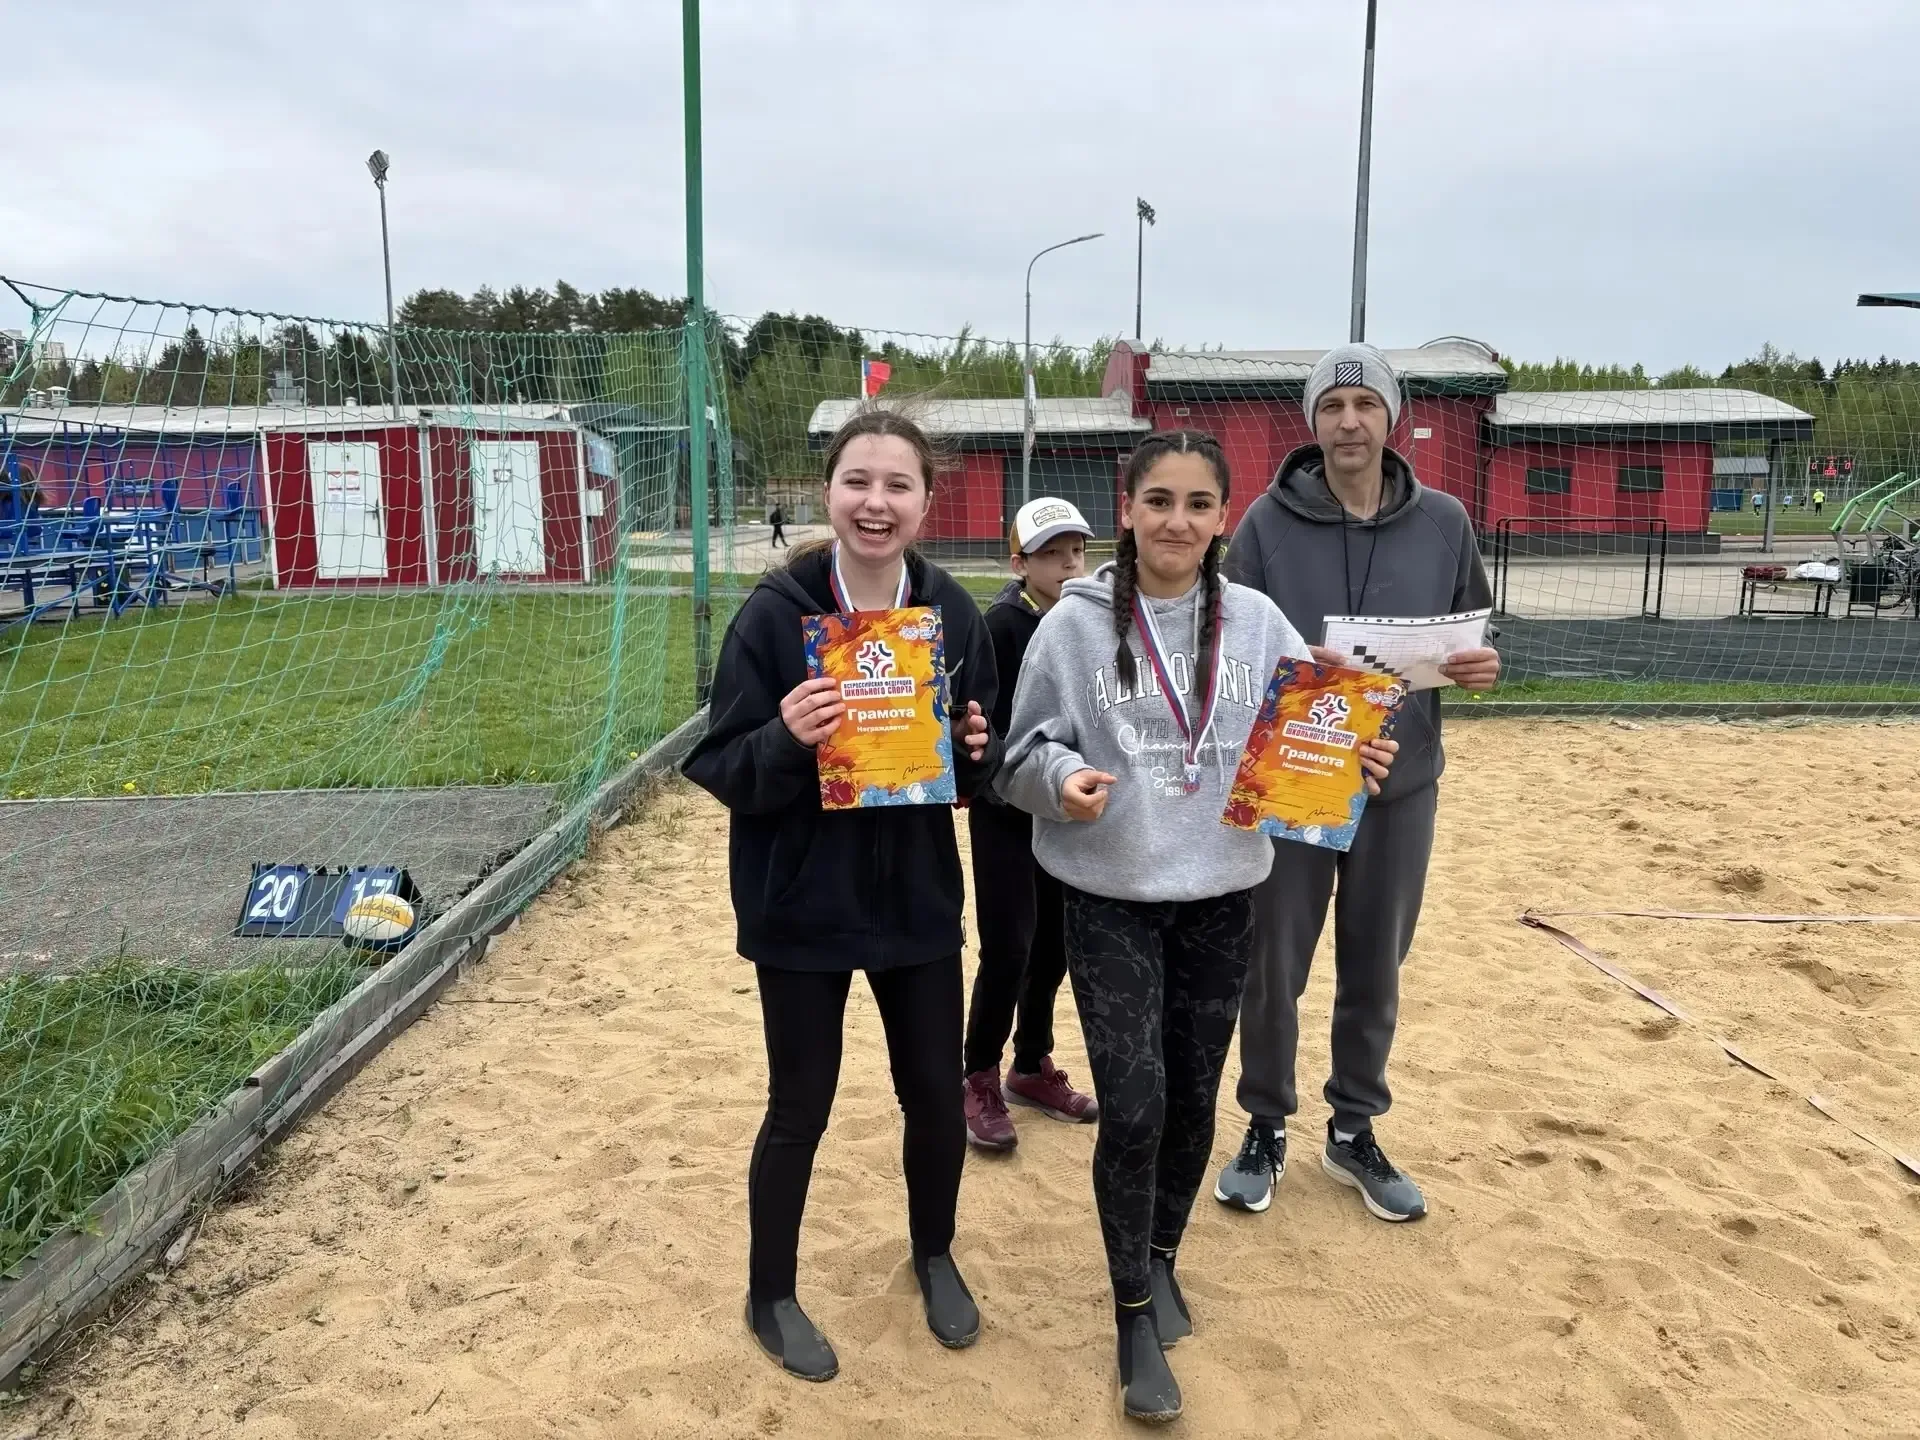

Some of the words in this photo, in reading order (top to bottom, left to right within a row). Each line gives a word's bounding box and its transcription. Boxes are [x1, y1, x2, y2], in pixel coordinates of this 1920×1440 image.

[844, 681, 883, 689] ВСЕРОССИЙСКАЯ
[884, 679, 912, 687] ФЕДЕРАЦИЯ
[844, 687, 886, 697] ШКОЛЬНОГО
[887, 685, 913, 695] СПОРТА
[847, 708, 916, 722] Грамота
[857, 724, 910, 733] Награждается
[1288, 722, 1327, 733] ВСЕРОССИЙСКАЯ
[1327, 730, 1355, 740] ФЕДЕРАЦИЯ
[1286, 728, 1326, 741] ШКОЛЬНОГО
[1327, 735, 1352, 747] СПОРТА
[1279, 744, 1345, 768] Грамота
[1281, 761, 1334, 777] Награждается
[250, 875, 299, 918] 20
